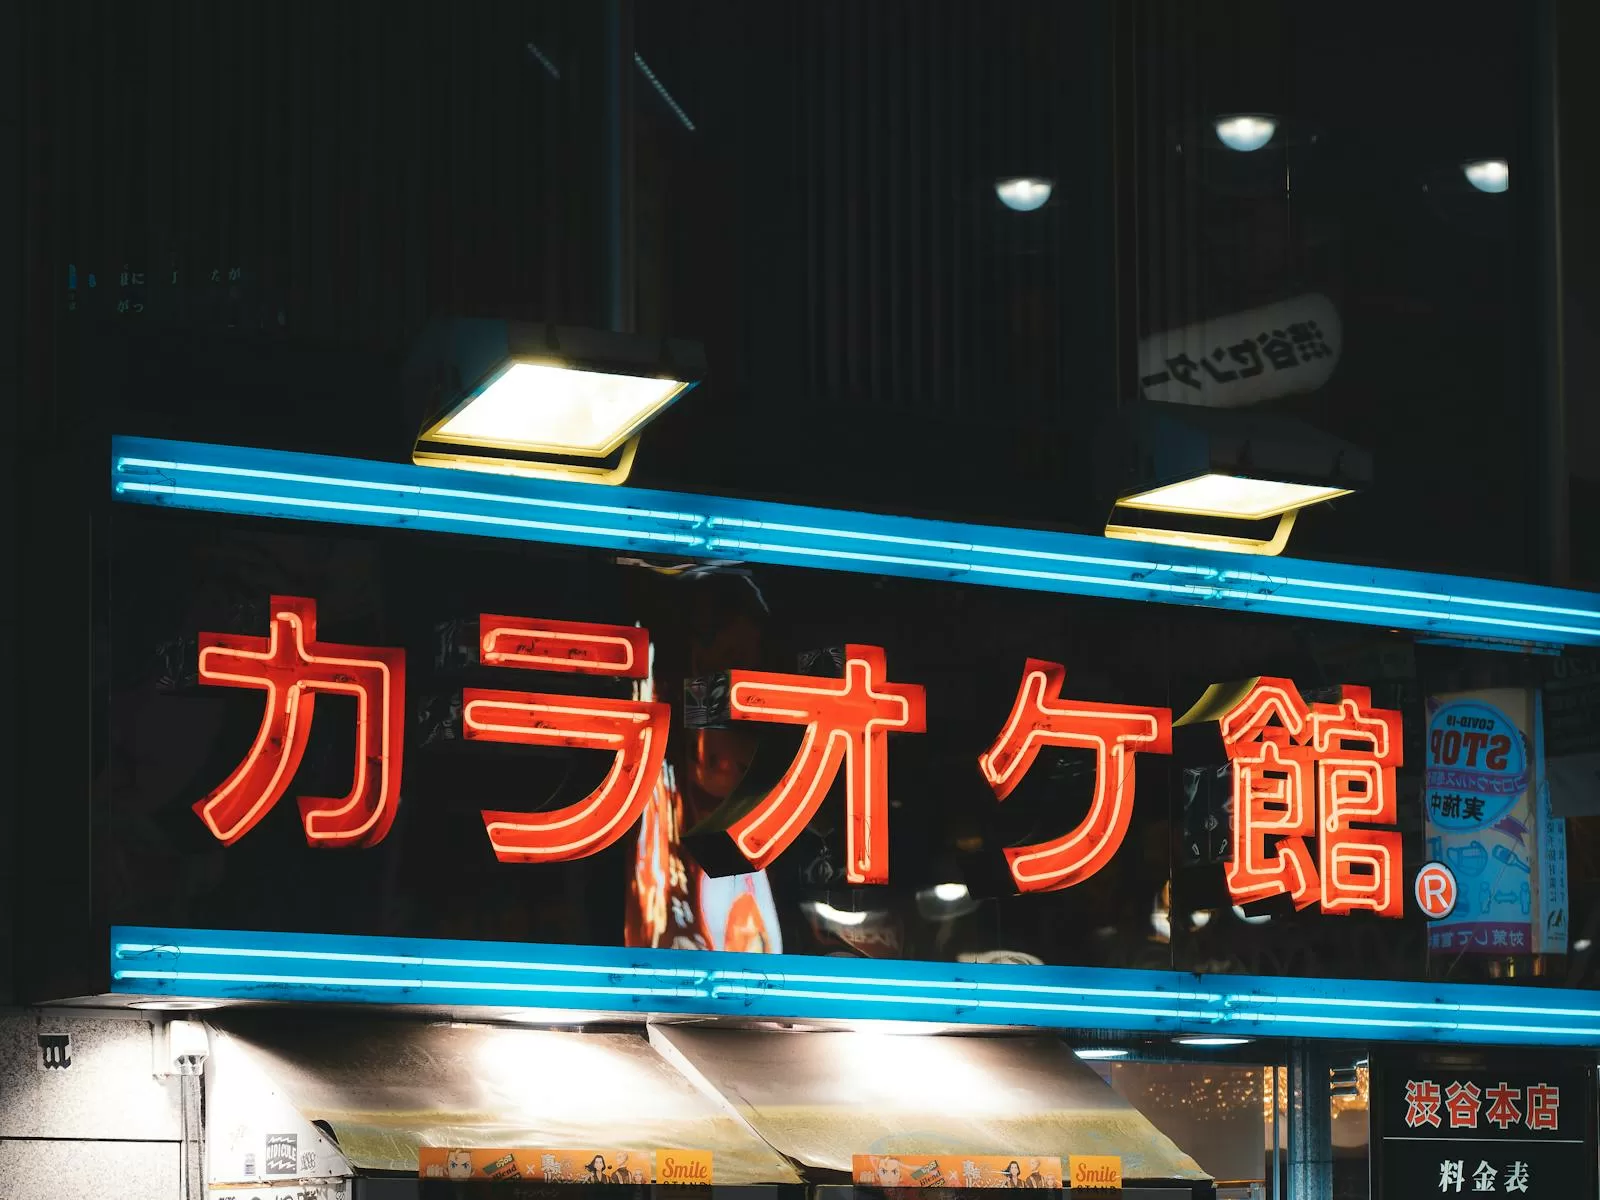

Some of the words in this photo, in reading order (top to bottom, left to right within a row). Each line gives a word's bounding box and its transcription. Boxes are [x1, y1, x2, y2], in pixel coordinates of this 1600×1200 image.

[192, 594, 1404, 920] カラオケ館
[1405, 1079, 1560, 1131] 渋谷本店
[663, 1158, 708, 1179] Smile
[1076, 1163, 1118, 1183] Smile
[1438, 1160, 1530, 1193] 料金表
